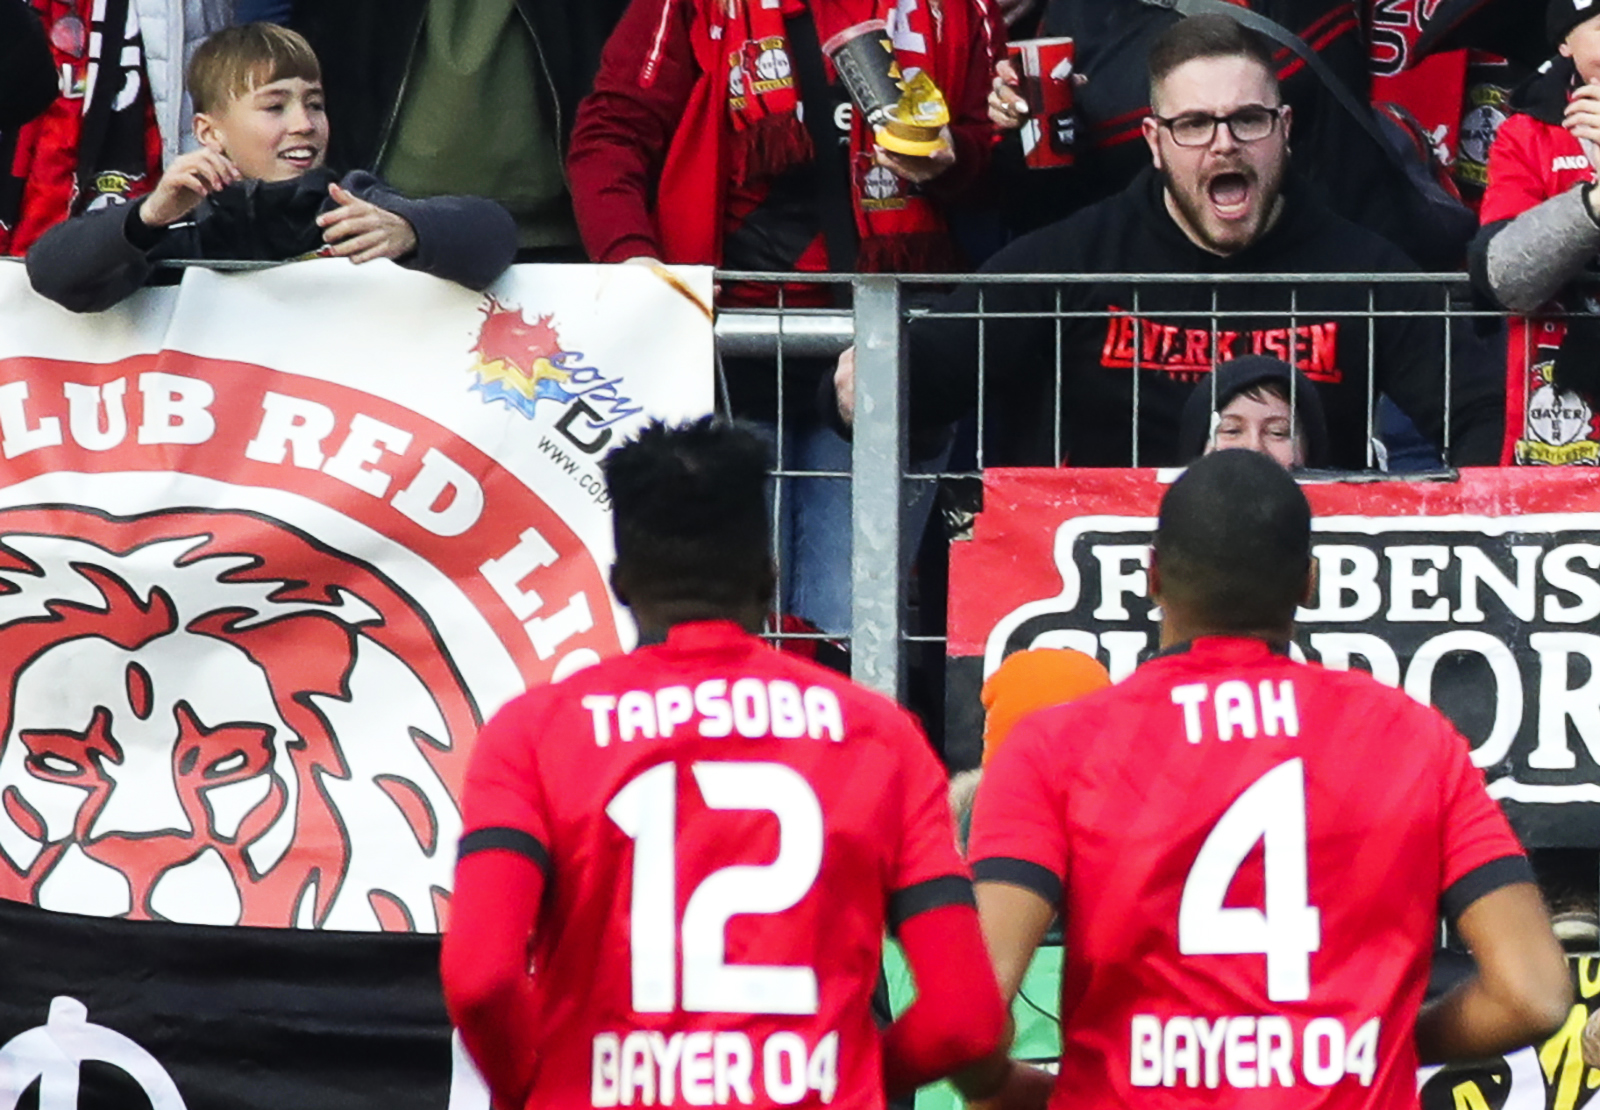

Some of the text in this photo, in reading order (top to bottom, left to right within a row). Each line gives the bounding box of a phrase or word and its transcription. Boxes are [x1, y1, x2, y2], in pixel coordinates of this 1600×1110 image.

[1552, 155, 1589, 172] JAKO
[549, 351, 644, 429] copy
[553, 397, 614, 468] D
[245, 391, 486, 537] RED
[478, 526, 601, 685] LI
[581, 679, 845, 747] TAPSOBA
[1170, 679, 1300, 744] TAH
[605, 760, 825, 1016] 12
[1178, 757, 1320, 1002] 4
[591, 1029, 840, 1108] BAYER 04
[1130, 1013, 1380, 1088] BAYER 04
